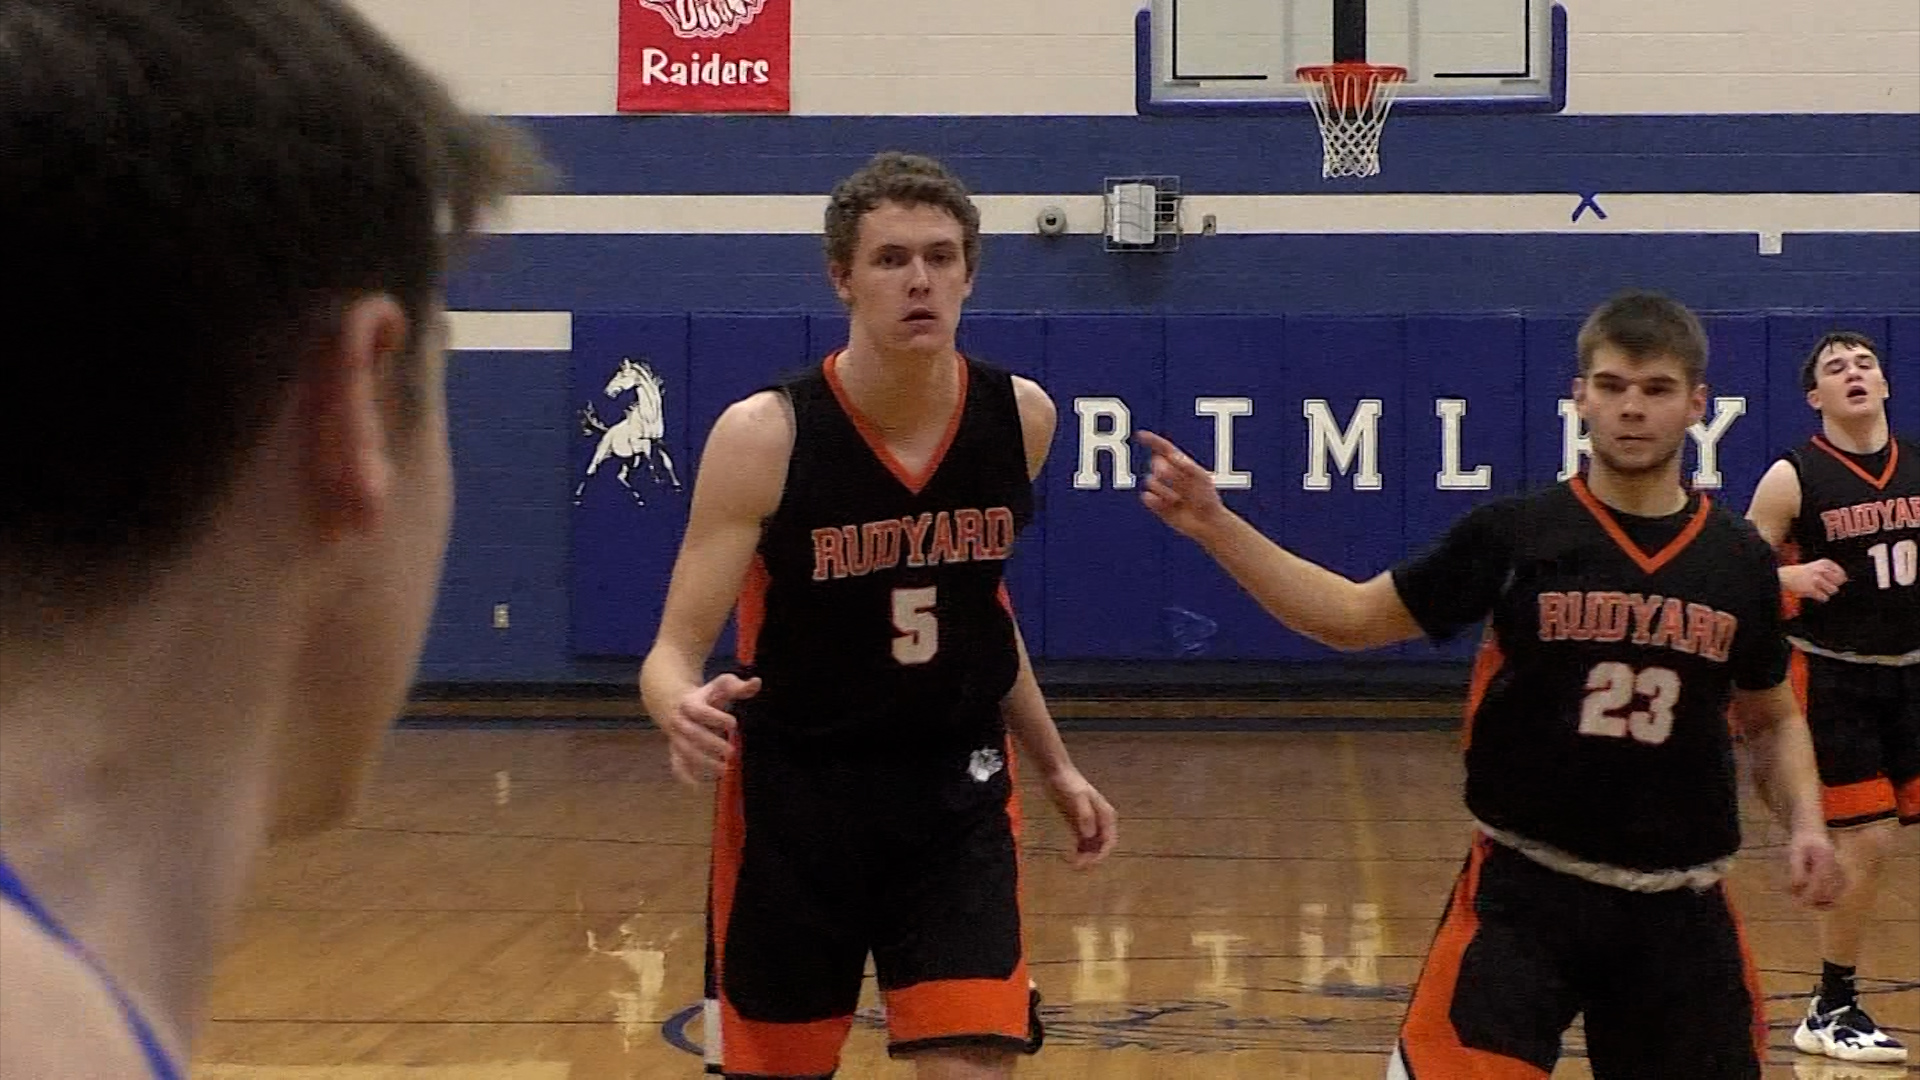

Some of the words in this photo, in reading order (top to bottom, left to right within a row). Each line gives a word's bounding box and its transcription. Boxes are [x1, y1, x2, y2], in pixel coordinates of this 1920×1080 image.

[642, 47, 769, 86] Raiders
[811, 506, 1014, 581] RUDYARD
[1867, 539, 1918, 589] 10
[891, 586, 938, 665] 5
[1538, 591, 1738, 662] RUDYARD
[1578, 661, 1681, 744] 23
